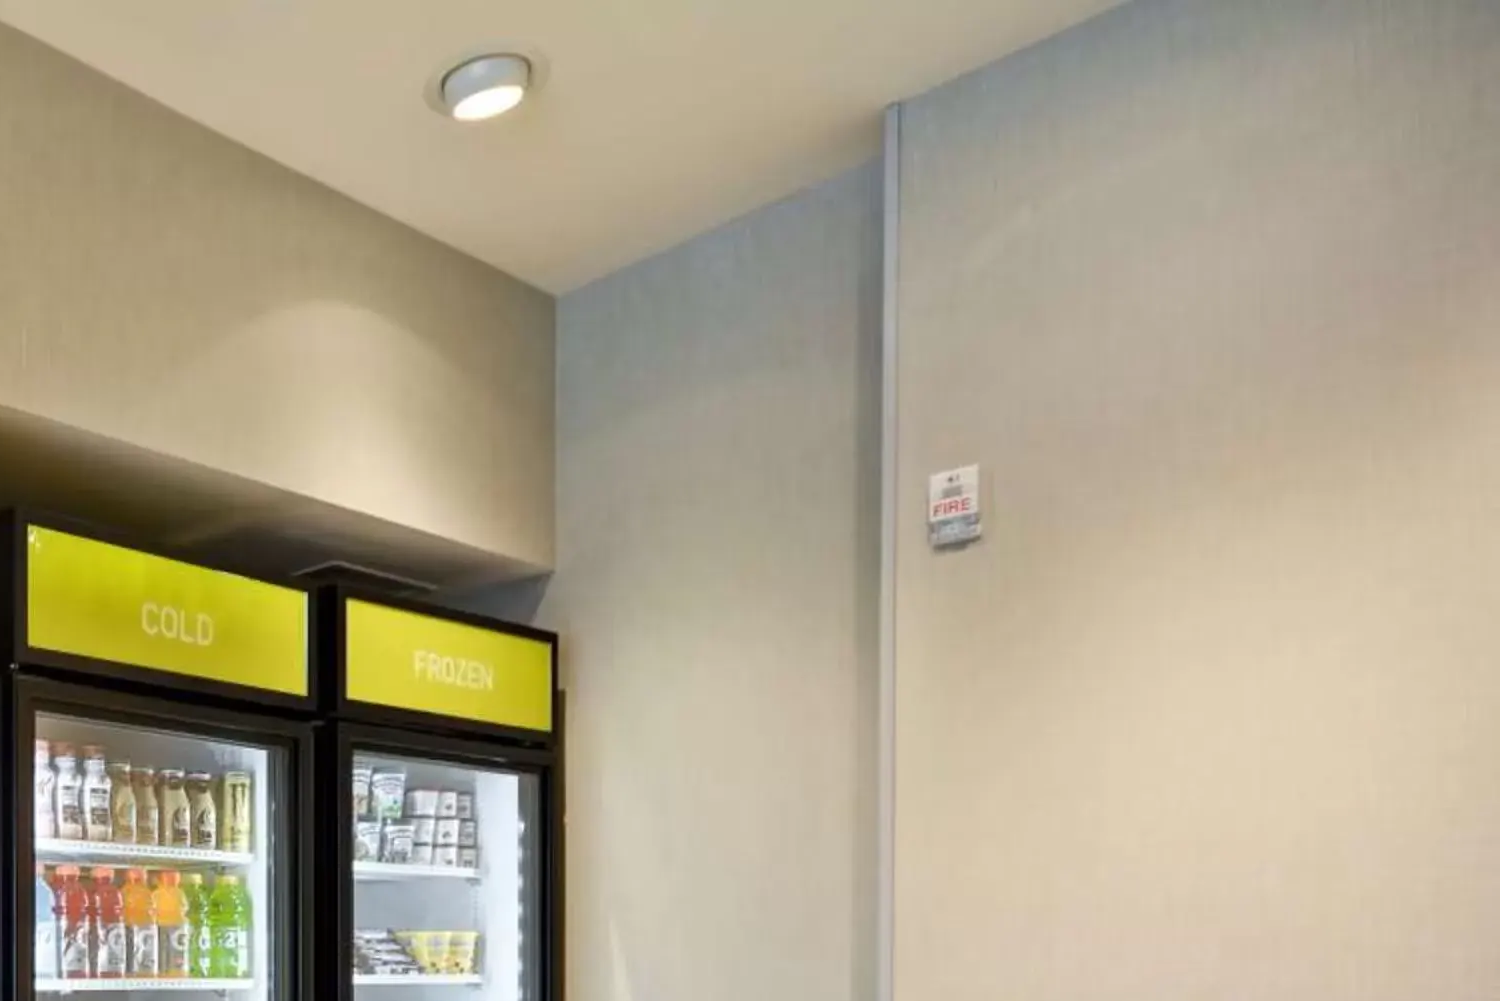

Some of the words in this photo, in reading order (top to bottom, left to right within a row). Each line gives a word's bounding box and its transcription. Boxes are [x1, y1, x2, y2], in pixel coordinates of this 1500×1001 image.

[932, 497, 971, 517] FIRE
[141, 602, 214, 647] COLD
[413, 650, 494, 691] FROZEN
